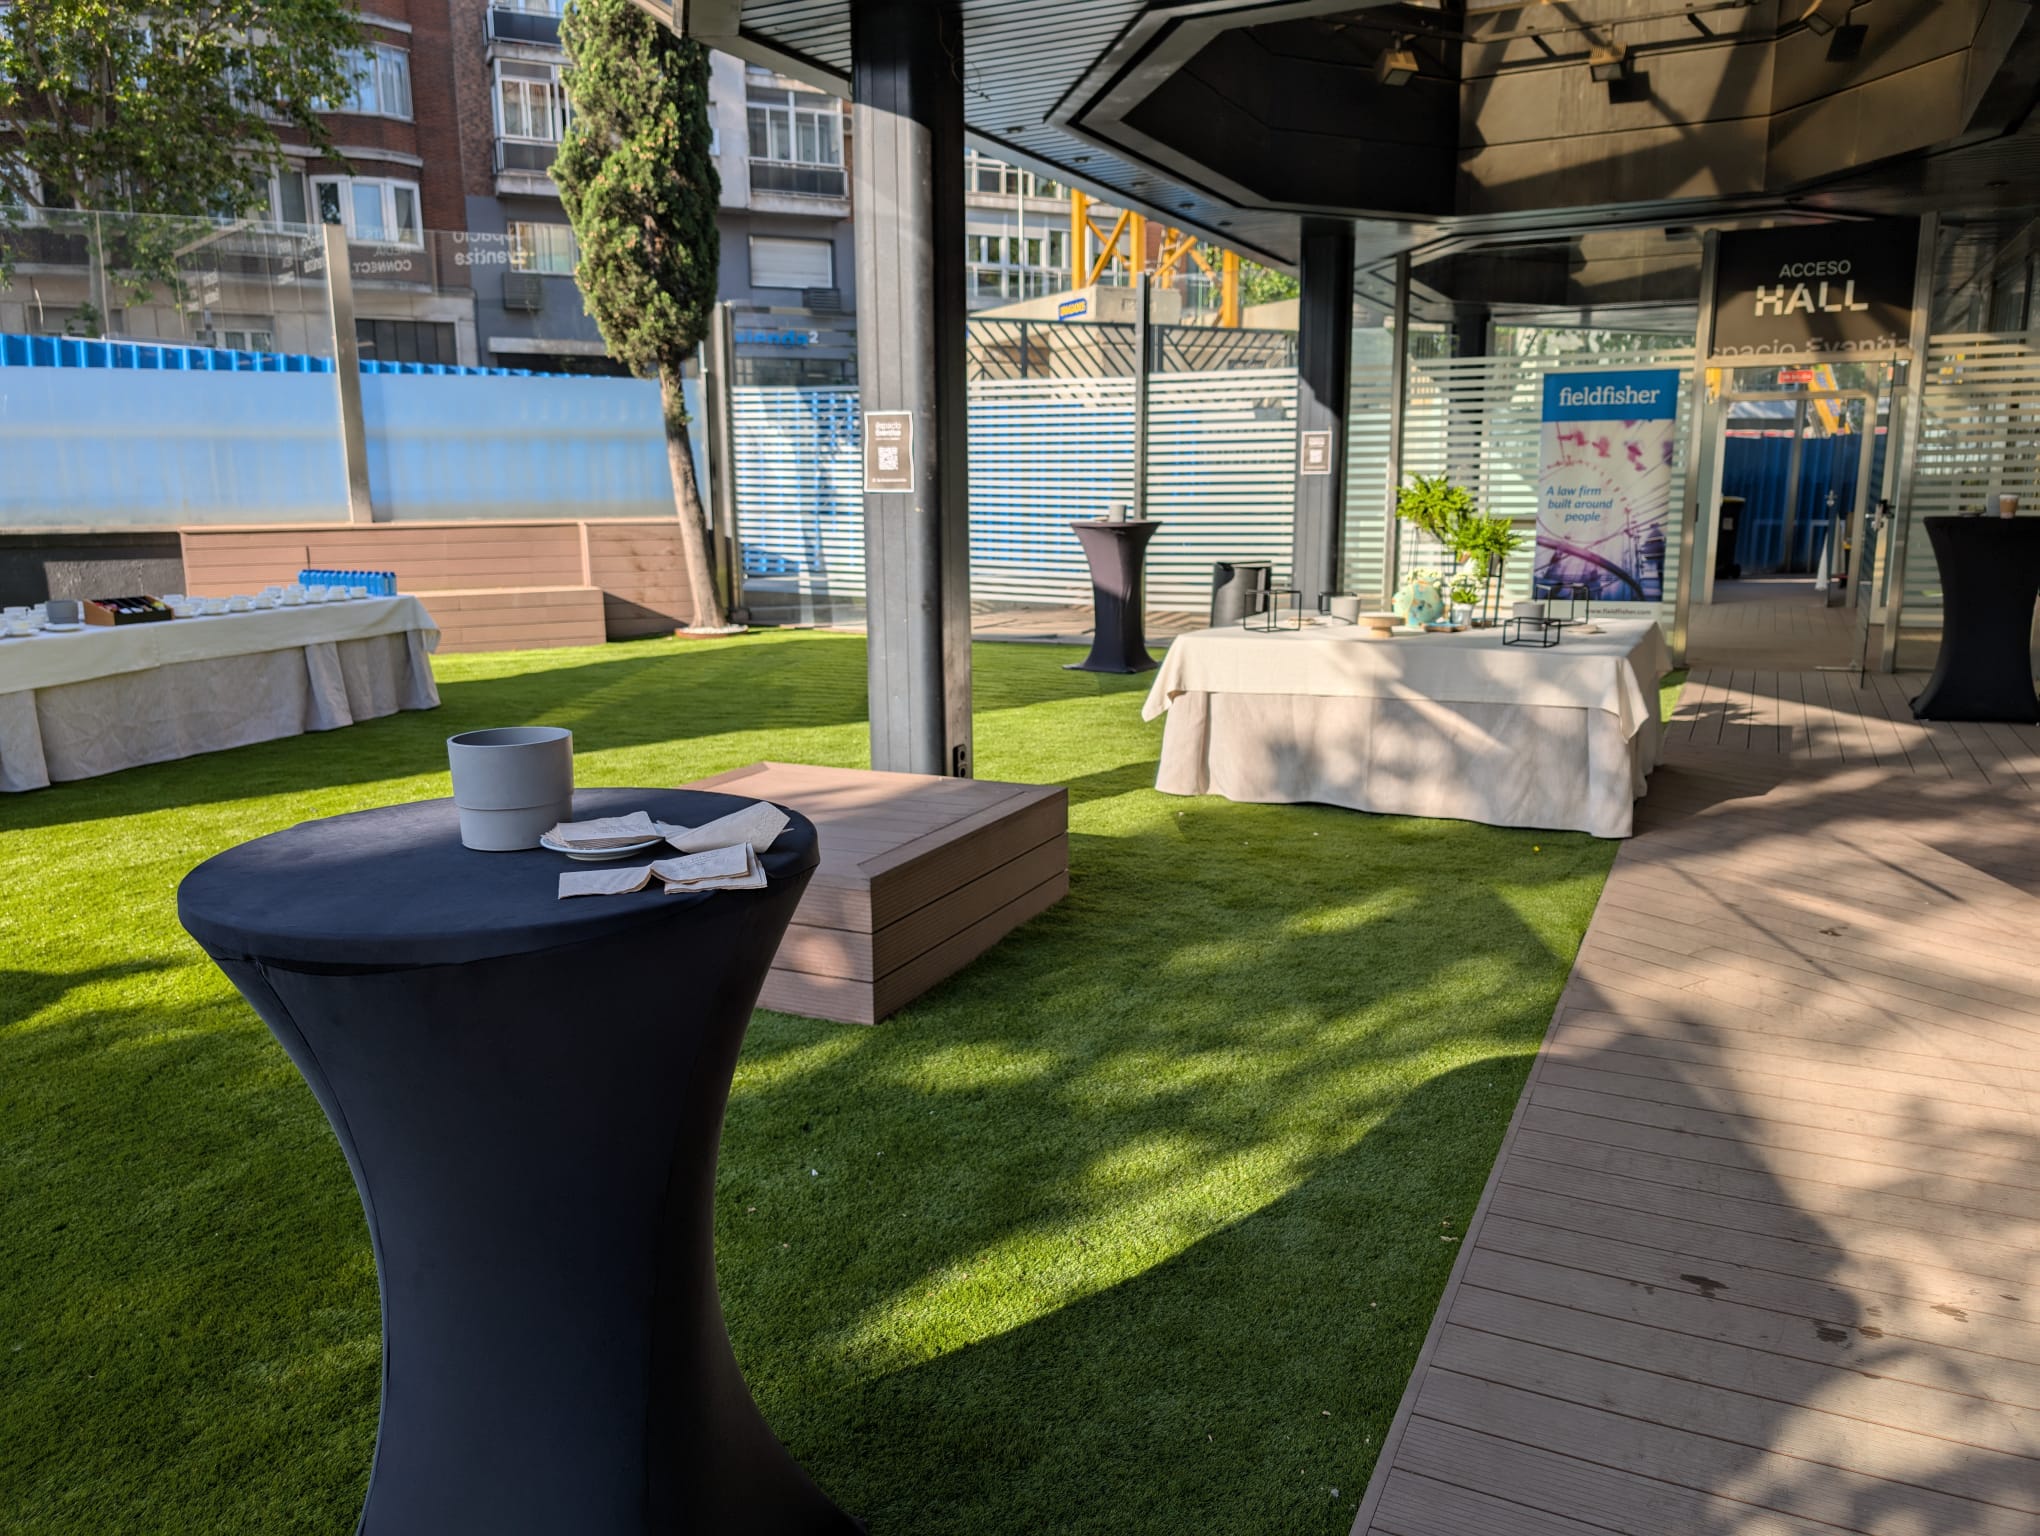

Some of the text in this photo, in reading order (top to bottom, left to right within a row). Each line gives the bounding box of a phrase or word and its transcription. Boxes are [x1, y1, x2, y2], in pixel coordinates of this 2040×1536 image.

[1779, 260, 1851, 278] ACCESO
[1754, 280, 1868, 316] HALL
[1558, 386, 1660, 406] fieldfisher
[1546, 485, 1602, 497] A law firm
[1548, 499, 1613, 509] built around
[1564, 511, 1601, 523] people
